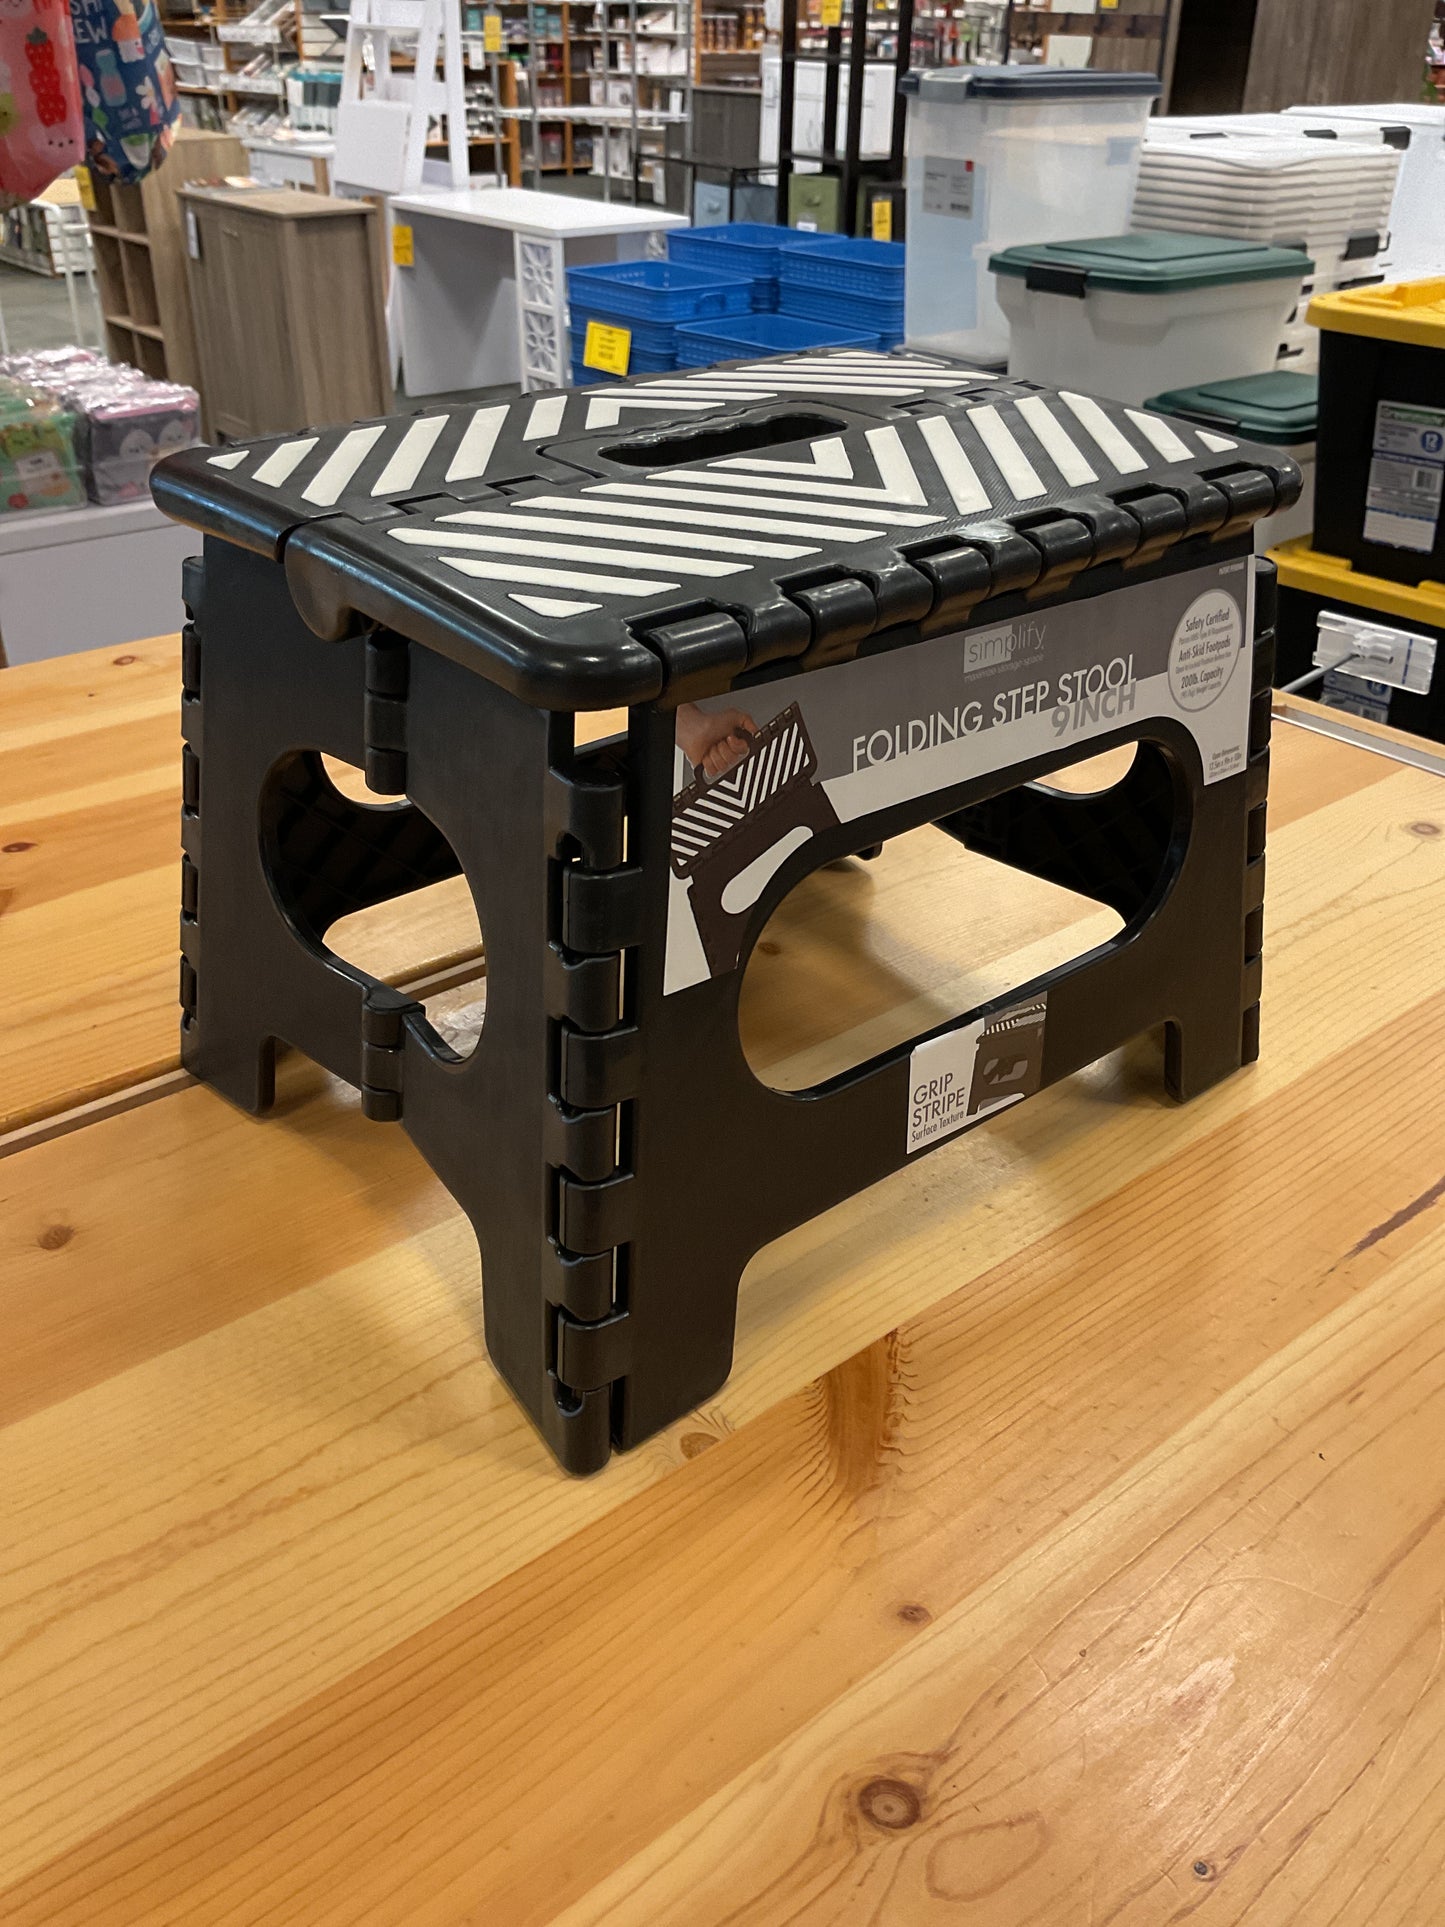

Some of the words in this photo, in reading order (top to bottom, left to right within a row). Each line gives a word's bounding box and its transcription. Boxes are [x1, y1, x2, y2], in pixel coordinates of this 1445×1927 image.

[1186, 617, 1204, 632] Safety
[1206, 607, 1230, 626] Certified
[968, 621, 1046, 663] simplify
[1179, 642, 1205, 662] Anti-Skid
[1206, 635, 1231, 654] Footpads
[1201, 666, 1224, 683] Capacity
[852, 701, 983, 773] FOLDING
[992, 680, 1050, 727] STEP
[1056, 654, 1137, 706] STOOL
[913, 1072, 953, 1105] GRIP
[912, 1086, 965, 1128] STRIPE
[911, 1123, 938, 1143] Surface
[939, 1110, 964, 1129] Texture
